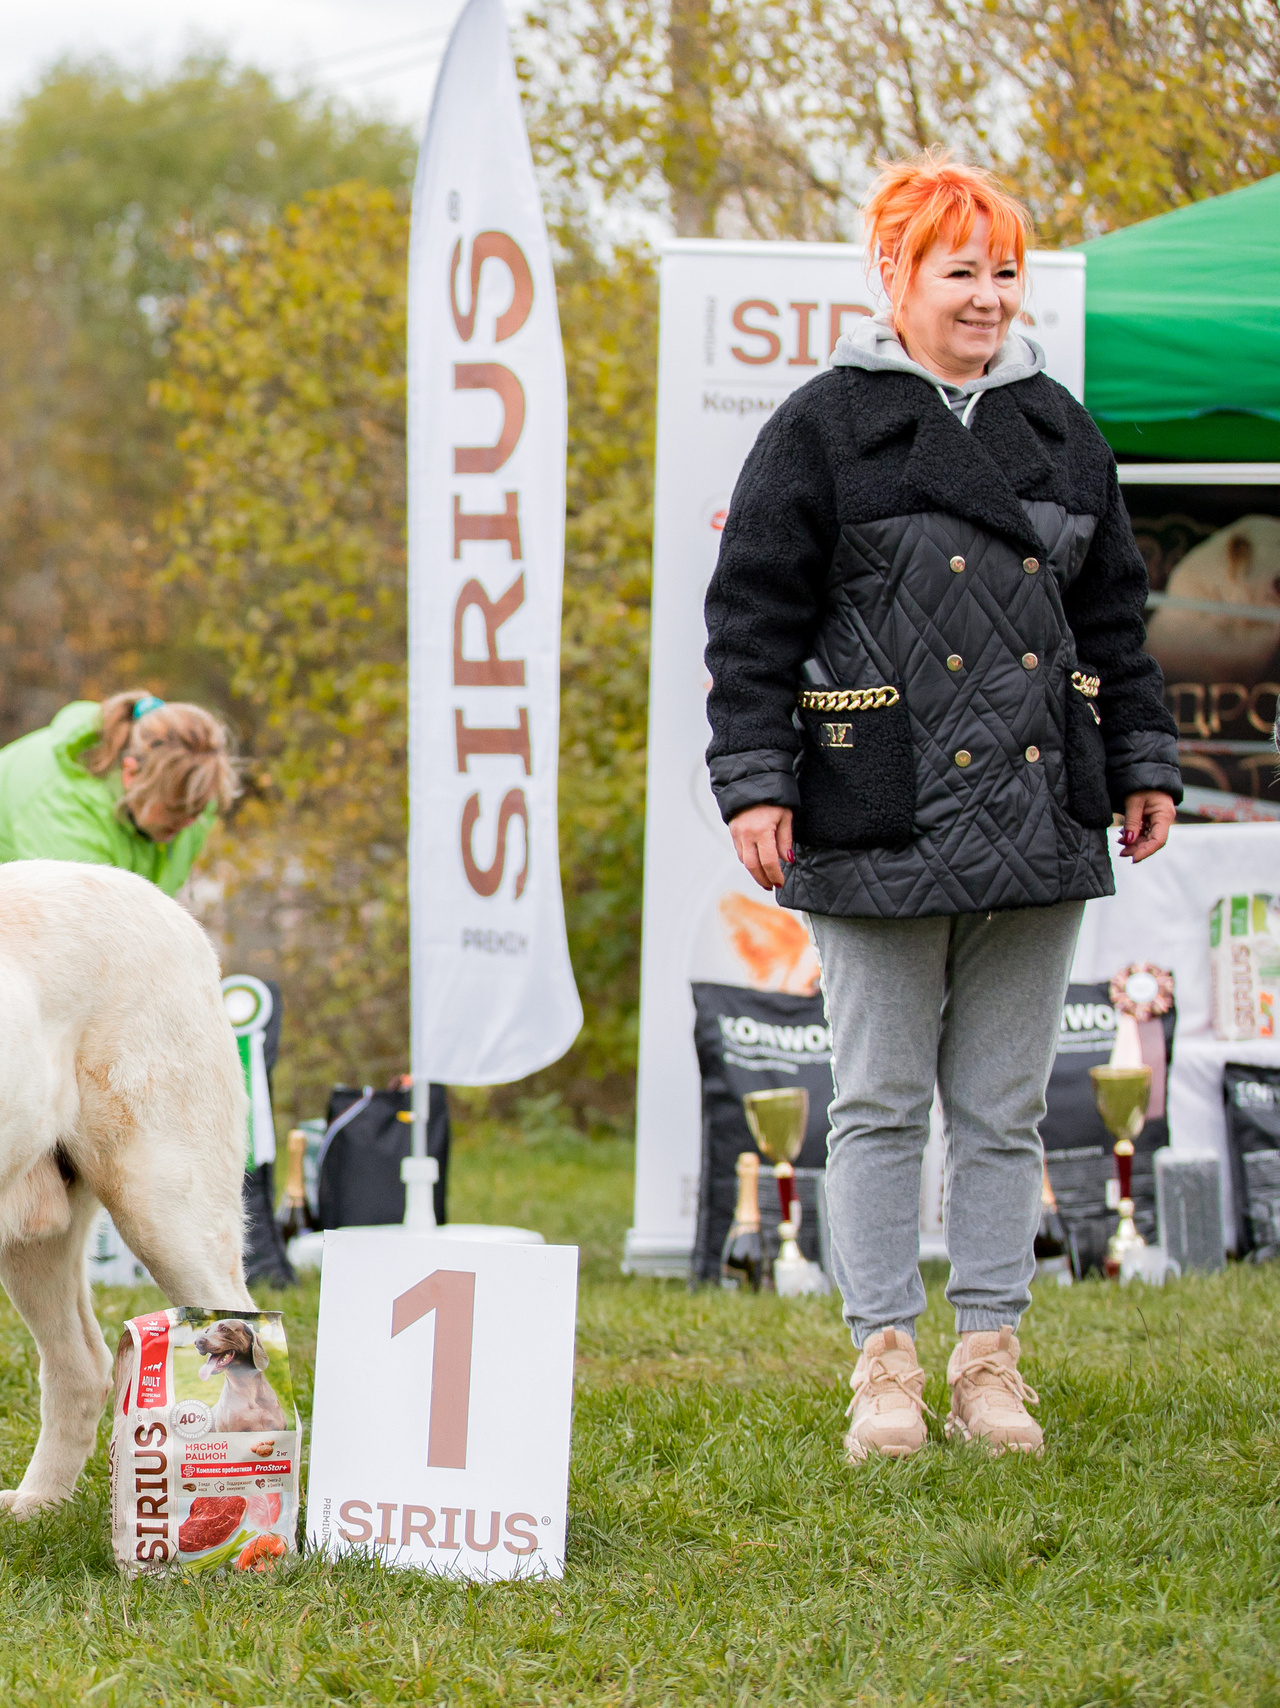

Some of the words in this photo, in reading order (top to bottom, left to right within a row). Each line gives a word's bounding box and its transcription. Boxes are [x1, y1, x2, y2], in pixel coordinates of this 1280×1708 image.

[450, 231, 533, 900] SIRIUS
[391, 1269, 476, 1469] 1
[141, 1376, 161, 1388] ADULT
[179, 1412, 207, 1425] 40%
[185, 1441, 228, 1452] МЯСНОЙ
[185, 1452, 227, 1462] РАЦИОН
[196, 1467, 221, 1475] Комплекс
[222, 1465, 253, 1475] пробиотиков
[255, 1463, 288, 1473] ProStor+
[134, 1422, 169, 1563] SIRIUS
